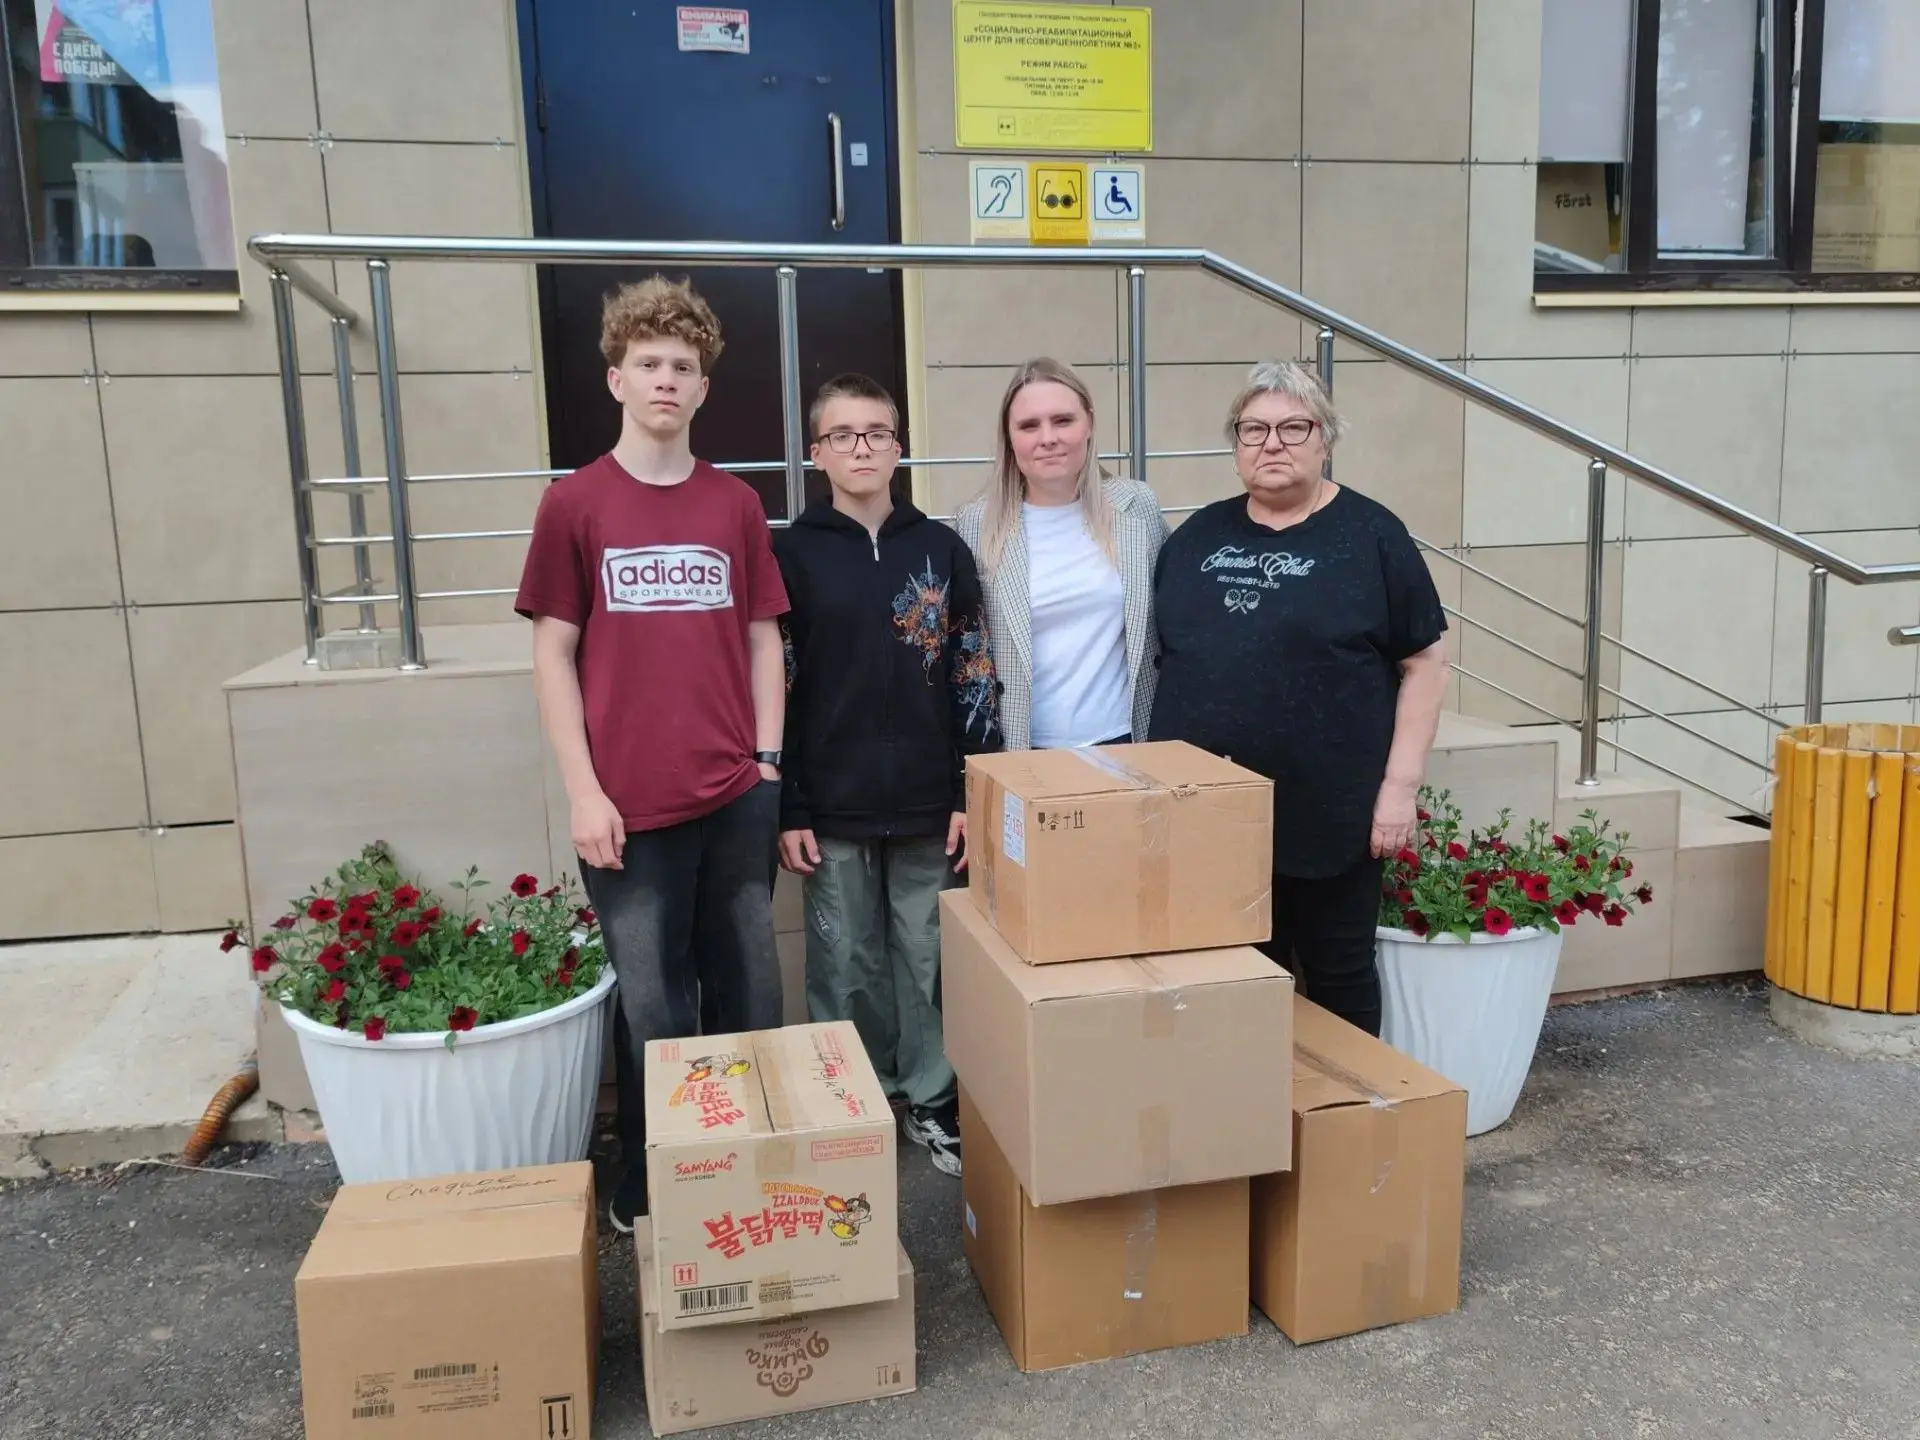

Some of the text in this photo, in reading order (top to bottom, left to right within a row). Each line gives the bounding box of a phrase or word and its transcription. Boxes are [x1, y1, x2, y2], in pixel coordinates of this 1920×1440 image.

[52, 40, 103, 59] С ДНЁМ
[963, 35, 992, 44] ЦЕНТР
[995, 36, 1013, 45] ДЛЯ
[1015, 37, 1121, 48] НЕСОВЕРШЕННОЛЕТНИХ
[54, 59, 117, 78] ПОБЕДЫ!
[1021, 60, 1051, 68] РЕЖИМ
[618, 559, 723, 586] adidas
[1259, 552, 1315, 581] Club
[620, 588, 723, 598] SPORTSWEAR
[674, 1158, 732, 1175] SAMYANG
[703, 1207, 824, 1260] 불닭짤떡
[745, 1331, 829, 1370] Дымка
